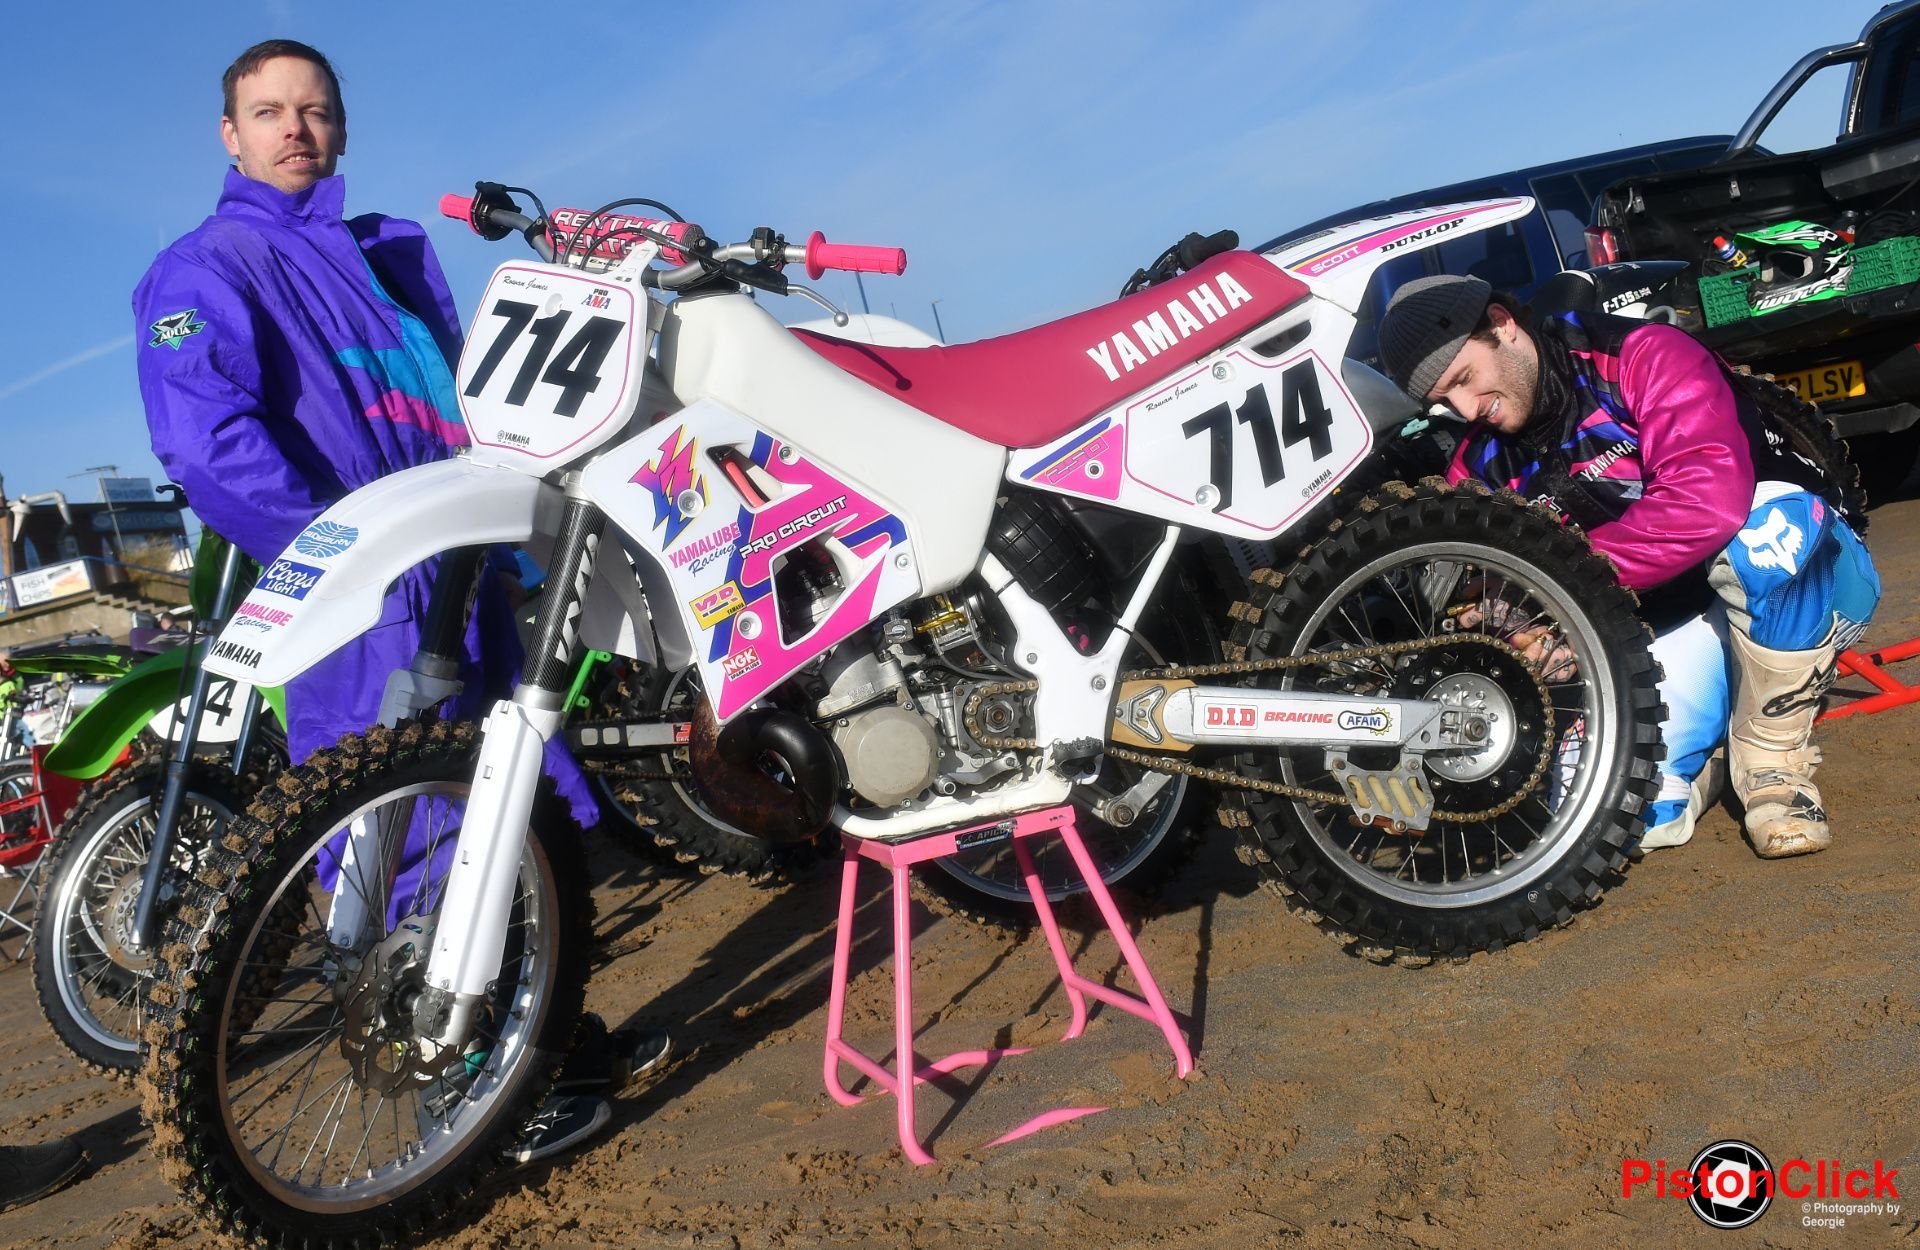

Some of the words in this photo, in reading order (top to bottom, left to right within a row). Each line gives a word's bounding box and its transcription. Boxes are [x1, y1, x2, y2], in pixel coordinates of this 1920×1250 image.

[554, 210, 676, 240] RENTHAL
[1380, 217, 1465, 253] DUNLOP
[555, 230, 677, 261] RENTHL
[1310, 245, 1361, 275] SCOTT
[525, 278, 548, 290] James
[593, 288, 609, 297] PRO
[581, 294, 612, 310] AMA
[1085, 271, 1254, 383] YAMAHA
[463, 299, 626, 419] 714
[1145, 396, 1173, 412] Rowan
[1174, 382, 1199, 400] James
[1807, 366, 1853, 399] LSV
[504, 431, 530, 446] YAMAHA
[1181, 357, 1333, 514] 714
[1580, 440, 1637, 482] YAMAHA
[1307, 468, 1333, 492] YAMAHA
[738, 530, 778, 560] PRO
[778, 495, 848, 540] CIRCUIT
[668, 522, 743, 569] YAMALUBE
[688, 541, 738, 578] Racing
[266, 561, 318, 588] Coors
[727, 602, 745, 616] YAMAHA
[234, 615, 273, 633] Racing
[210, 640, 263, 669] YAMAHA
[723, 647, 757, 674] NGK
[1206, 706, 1256, 727] D.I.D
[1264, 711, 1334, 724] BRAKING
[1346, 715, 1382, 728] AFAM
